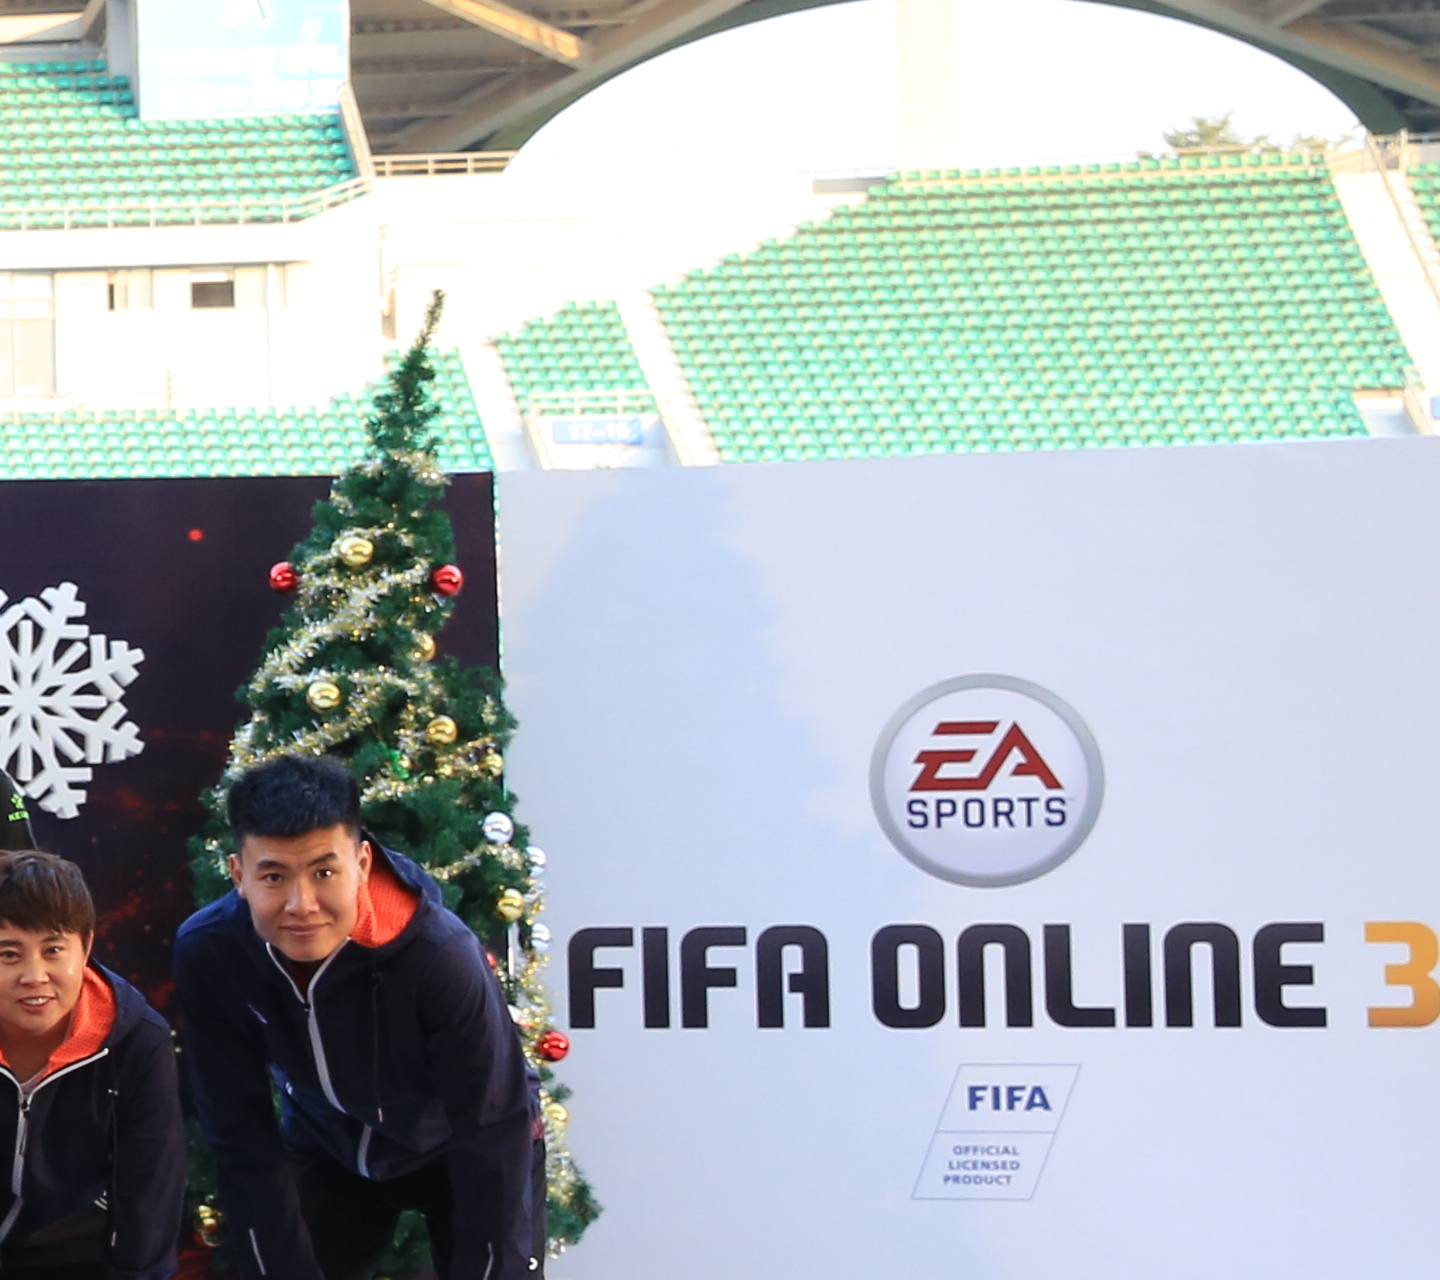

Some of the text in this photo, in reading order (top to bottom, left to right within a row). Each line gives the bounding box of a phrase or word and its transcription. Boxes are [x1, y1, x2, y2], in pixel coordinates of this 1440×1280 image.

[909, 721, 1064, 791] EA
[906, 797, 1067, 829] SPORTS
[566, 920, 1440, 1030] FIFA ONLINE 3
[967, 1085, 1052, 1111] FIFA
[952, 1145, 1020, 1156] OFFICIAL
[948, 1160, 1021, 1171] LICENSED
[943, 1175, 1013, 1185] PRODUCT
